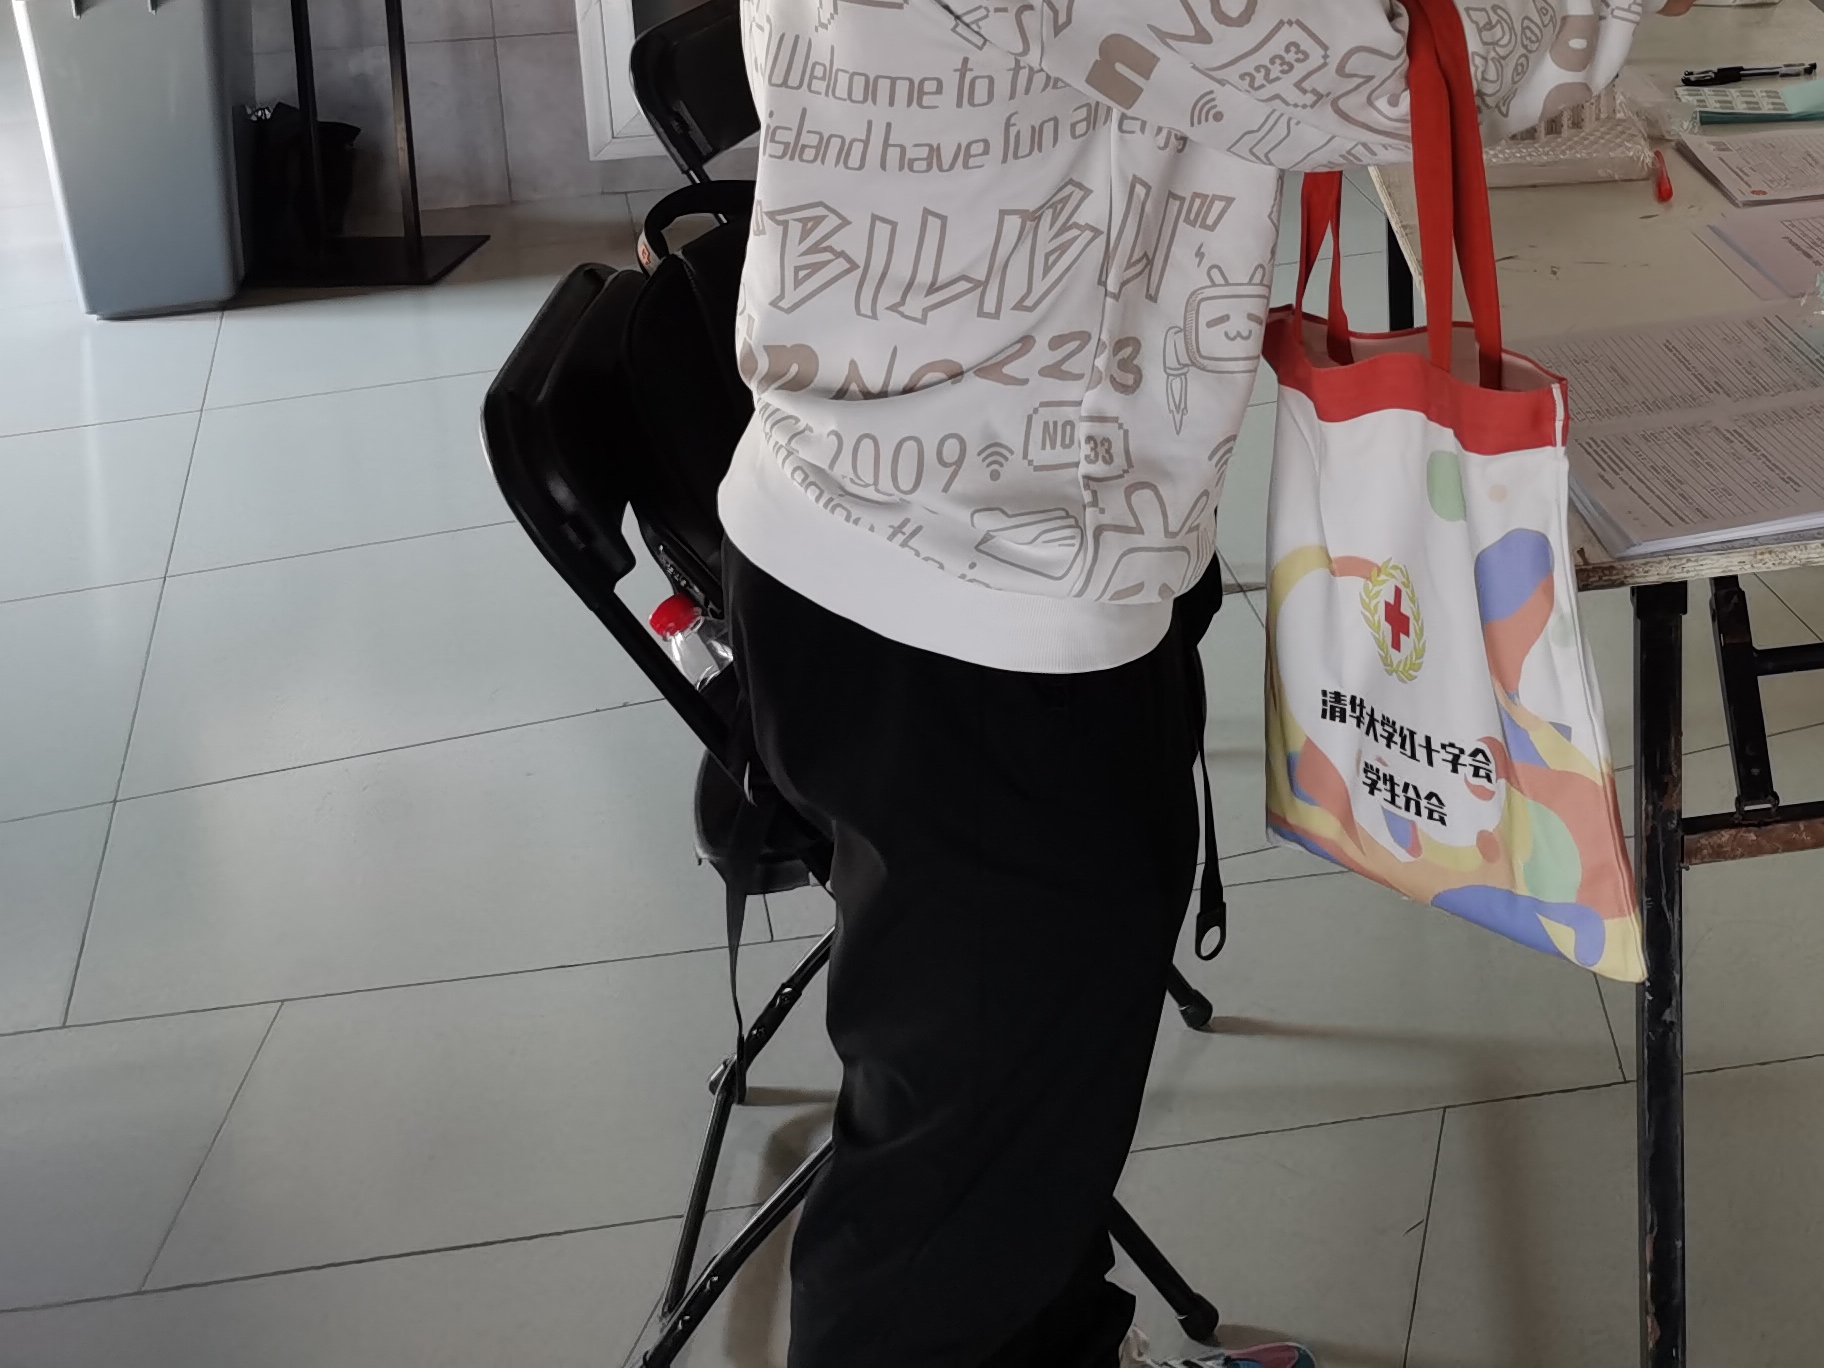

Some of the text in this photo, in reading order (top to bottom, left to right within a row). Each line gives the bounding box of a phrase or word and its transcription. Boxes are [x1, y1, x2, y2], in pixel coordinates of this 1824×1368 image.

[768, 32, 943, 111] Welcome
[952, 57, 995, 107] to
[763, 109, 875, 172] island
[880, 121, 990, 174] have
[1001, 101, 1060, 164] fun
[1321, 689, 1493, 784] 清华大学红十字会
[1362, 760, 1447, 827] 学生分会
